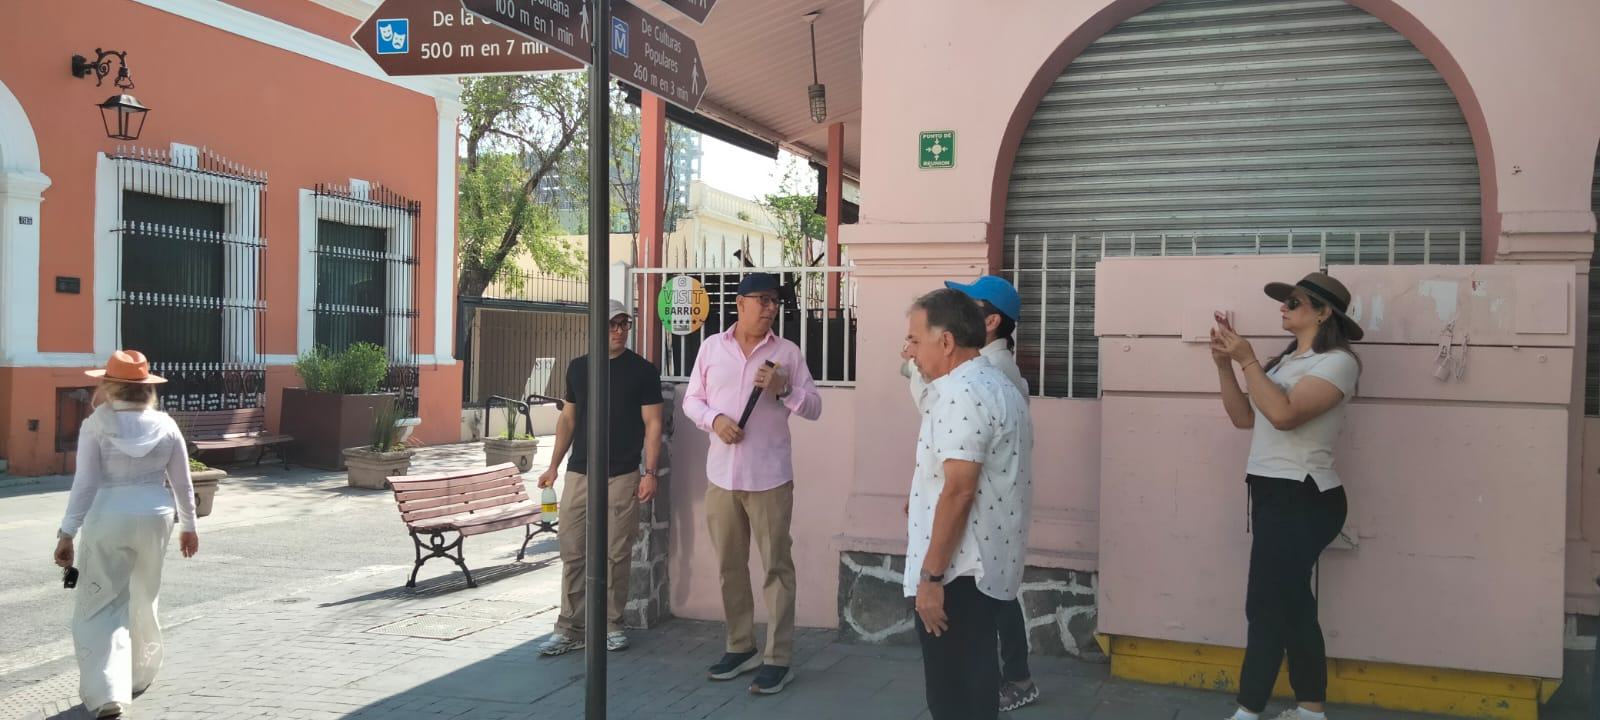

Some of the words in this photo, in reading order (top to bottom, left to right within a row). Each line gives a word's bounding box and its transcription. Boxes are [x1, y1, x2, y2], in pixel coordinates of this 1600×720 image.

[433, 11, 454, 27] De
[461, 8, 475, 25] la
[520, 8, 530, 26] m
[534, 16, 547, 33] en
[550, 19, 554, 37] 1
[557, 26, 574, 47] min
[641, 18, 652, 36] De
[654, 25, 682, 53] Culturas
[421, 42, 453, 59] 500
[460, 44, 475, 57] m
[481, 43, 500, 56] en
[506, 40, 515, 55] 7
[644, 42, 679, 73] Populares
[633, 61, 648, 82] 260
[650, 73, 657, 87] m
[660, 78, 669, 93] en
[671, 81, 675, 95] 3
[676, 86, 689, 102] min
[663, 289, 704, 305] VISIT
[664, 306, 701, 316] BARRIO
